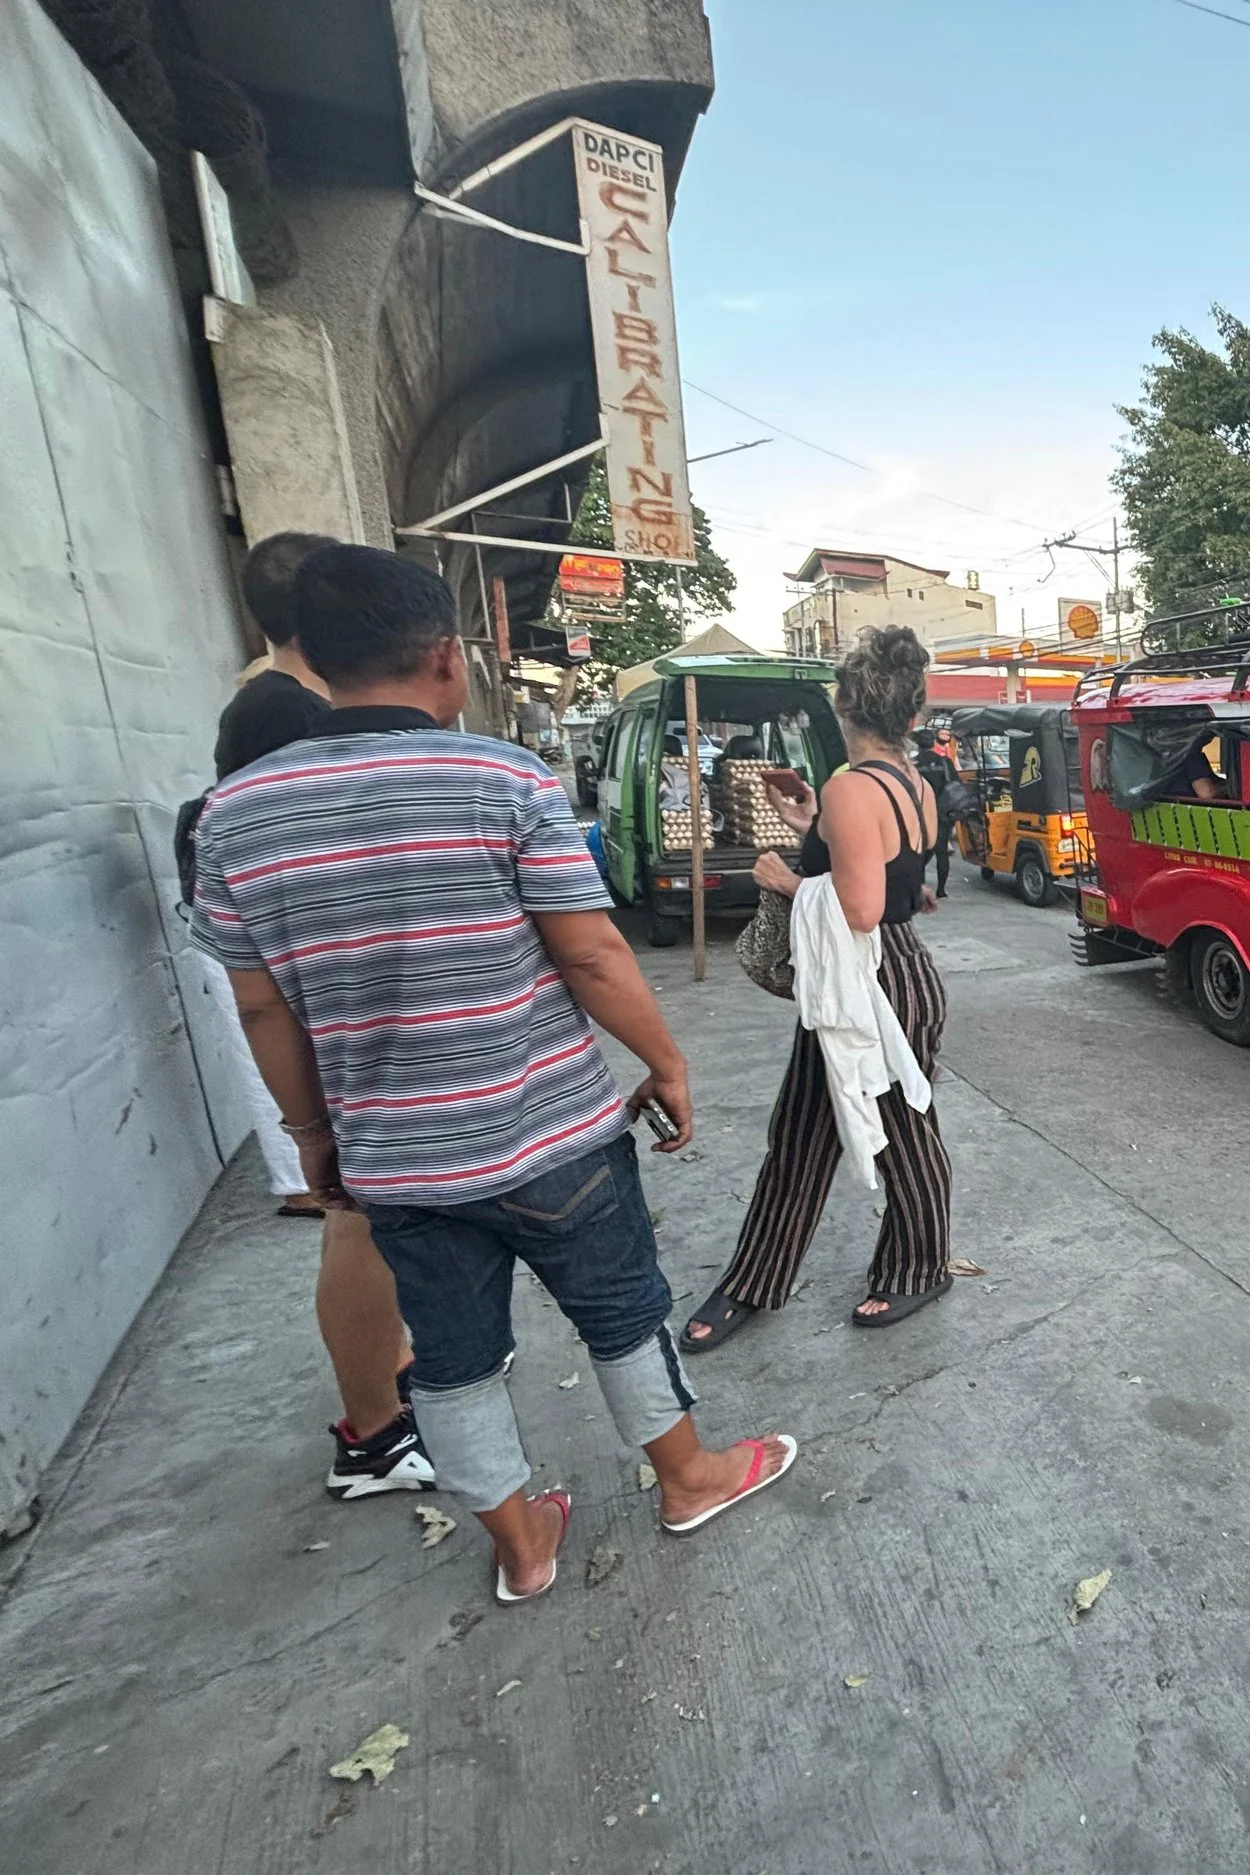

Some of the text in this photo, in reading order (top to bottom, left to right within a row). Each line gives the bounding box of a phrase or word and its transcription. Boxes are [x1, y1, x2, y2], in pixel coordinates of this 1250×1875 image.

[583, 132, 654, 173] DAPCI
[586, 157, 657, 192] DIESEL
[599, 181, 674, 526] CALIBRATING
